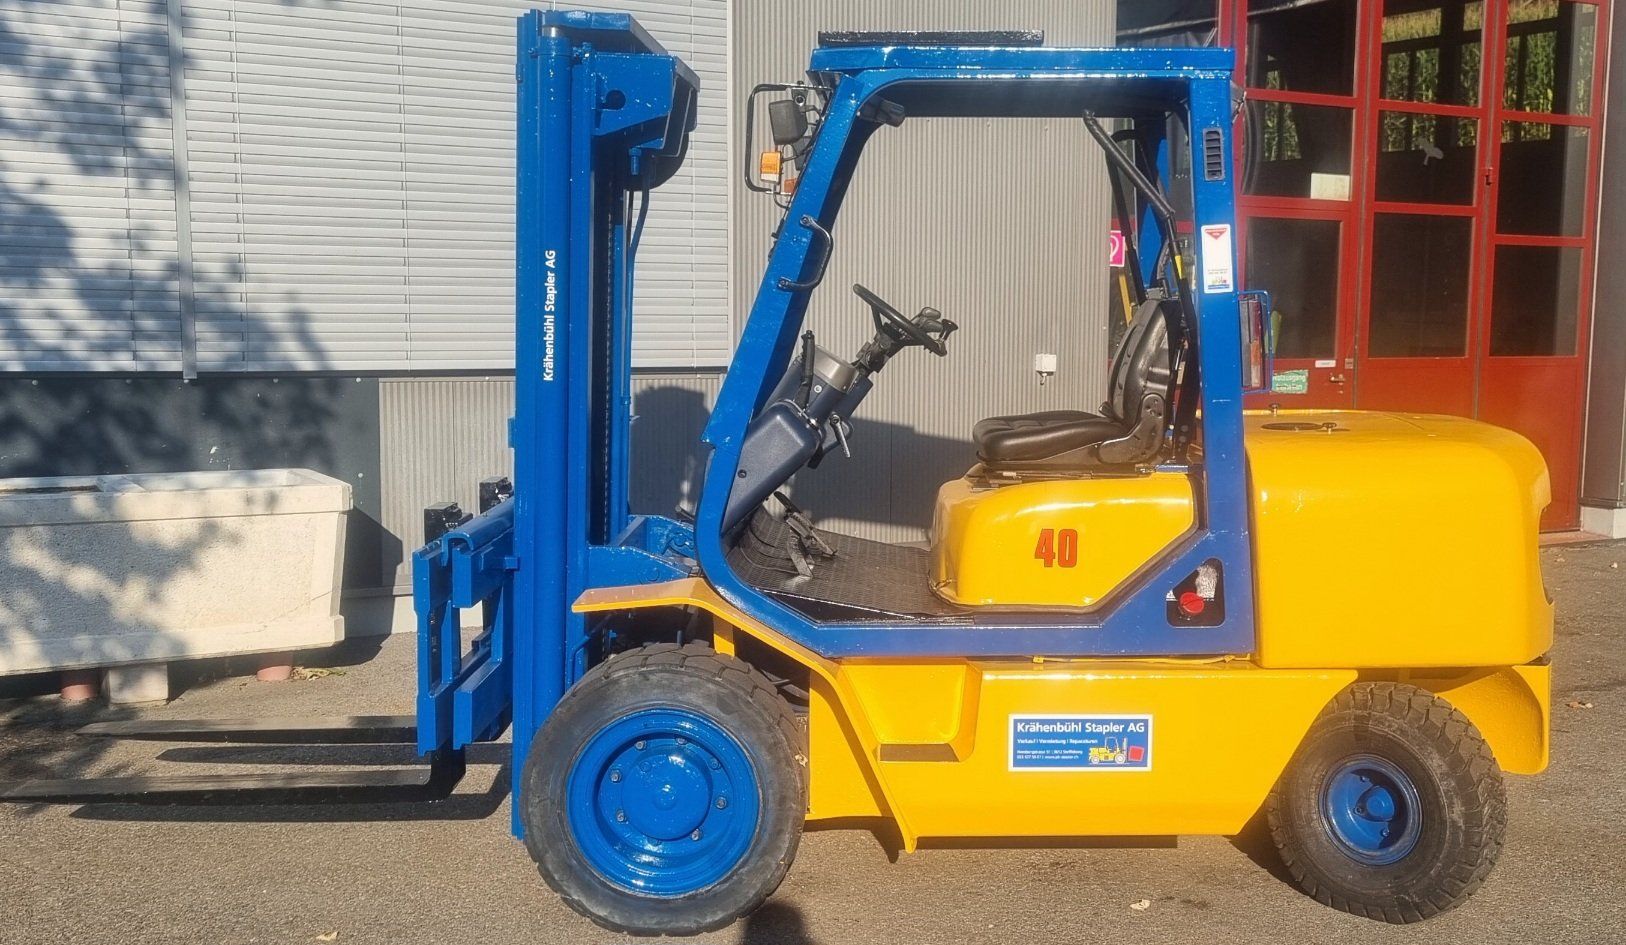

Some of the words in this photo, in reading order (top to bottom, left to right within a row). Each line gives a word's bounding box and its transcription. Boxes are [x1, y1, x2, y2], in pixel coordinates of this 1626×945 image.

[545, 250, 556, 268] AG
[544, 271, 557, 312] Stapler
[543, 315, 555, 381] Krähenbühl
[1034, 528, 1078, 568] 40
[1017, 722, 1082, 733] Krähenbühl
[1085, 722, 1125, 735] Stapler
[1127, 722, 1145, 733] AG
